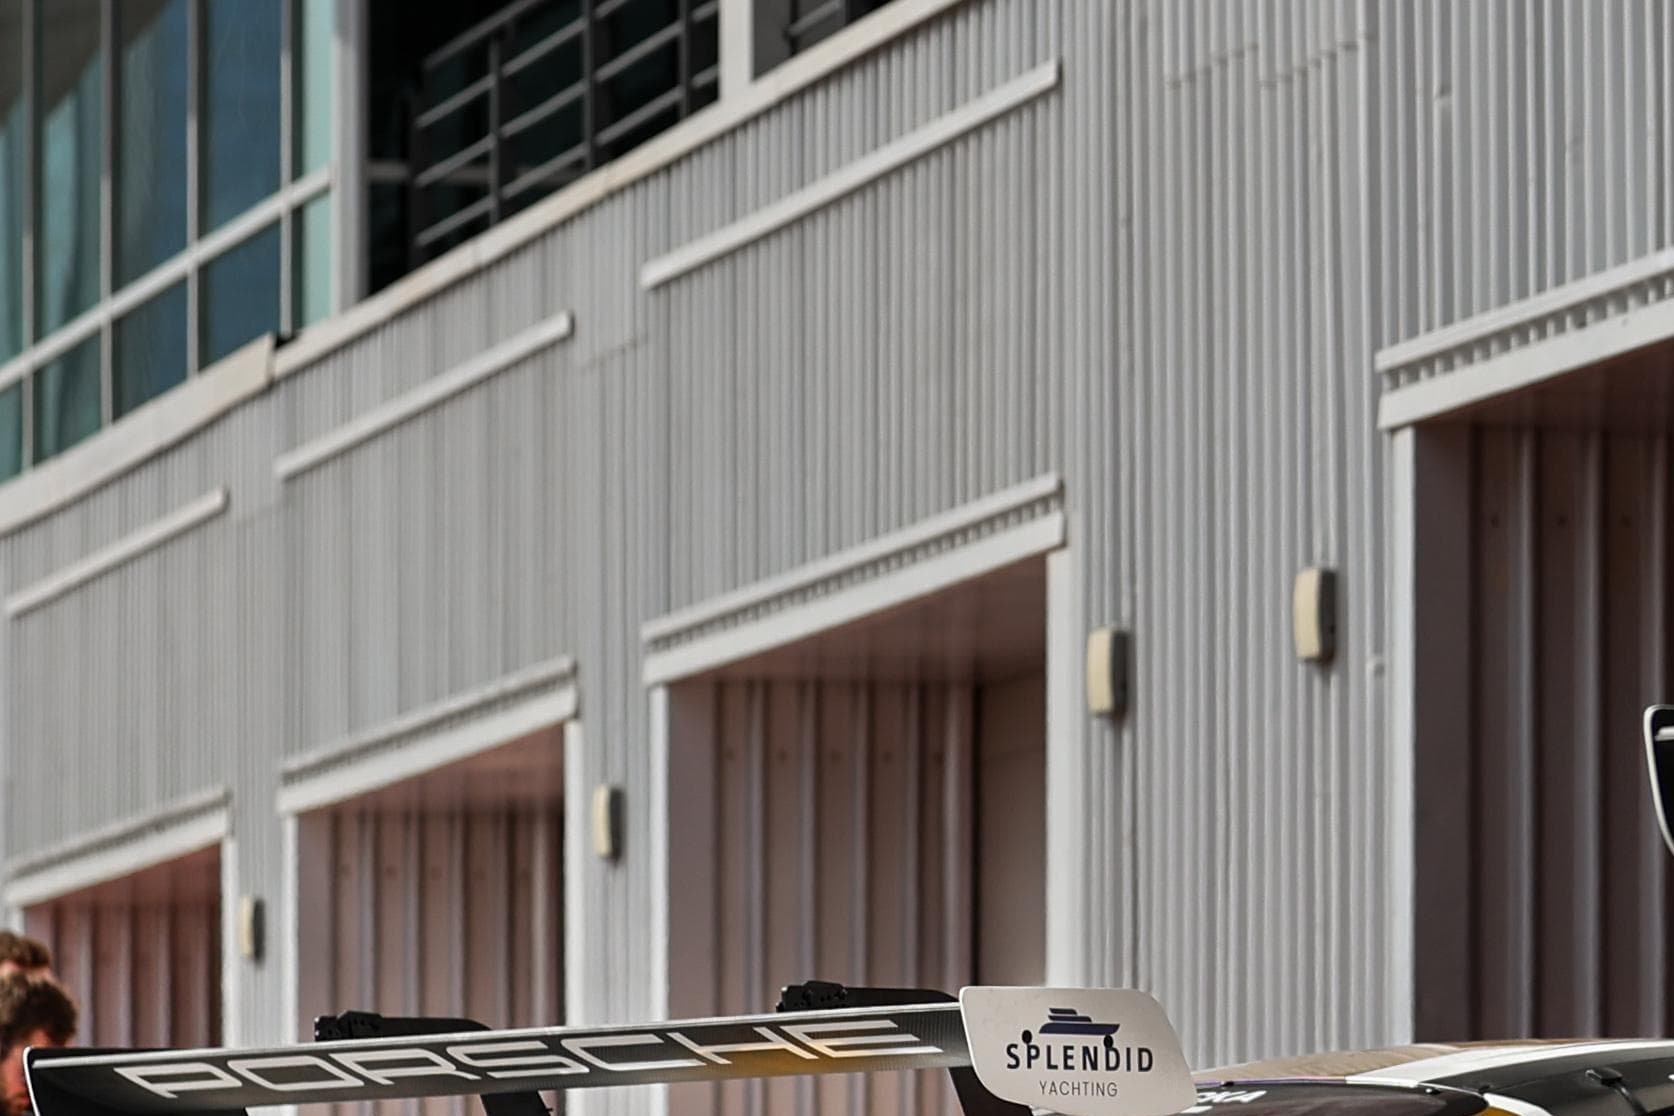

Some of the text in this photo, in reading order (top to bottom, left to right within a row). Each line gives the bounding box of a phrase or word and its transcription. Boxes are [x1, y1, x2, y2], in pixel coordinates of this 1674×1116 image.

[114, 1019, 945, 1099] PORSCHE
[1006, 1042, 1155, 1073] SPLENDID
[1039, 1081, 1119, 1098] YACHTING
